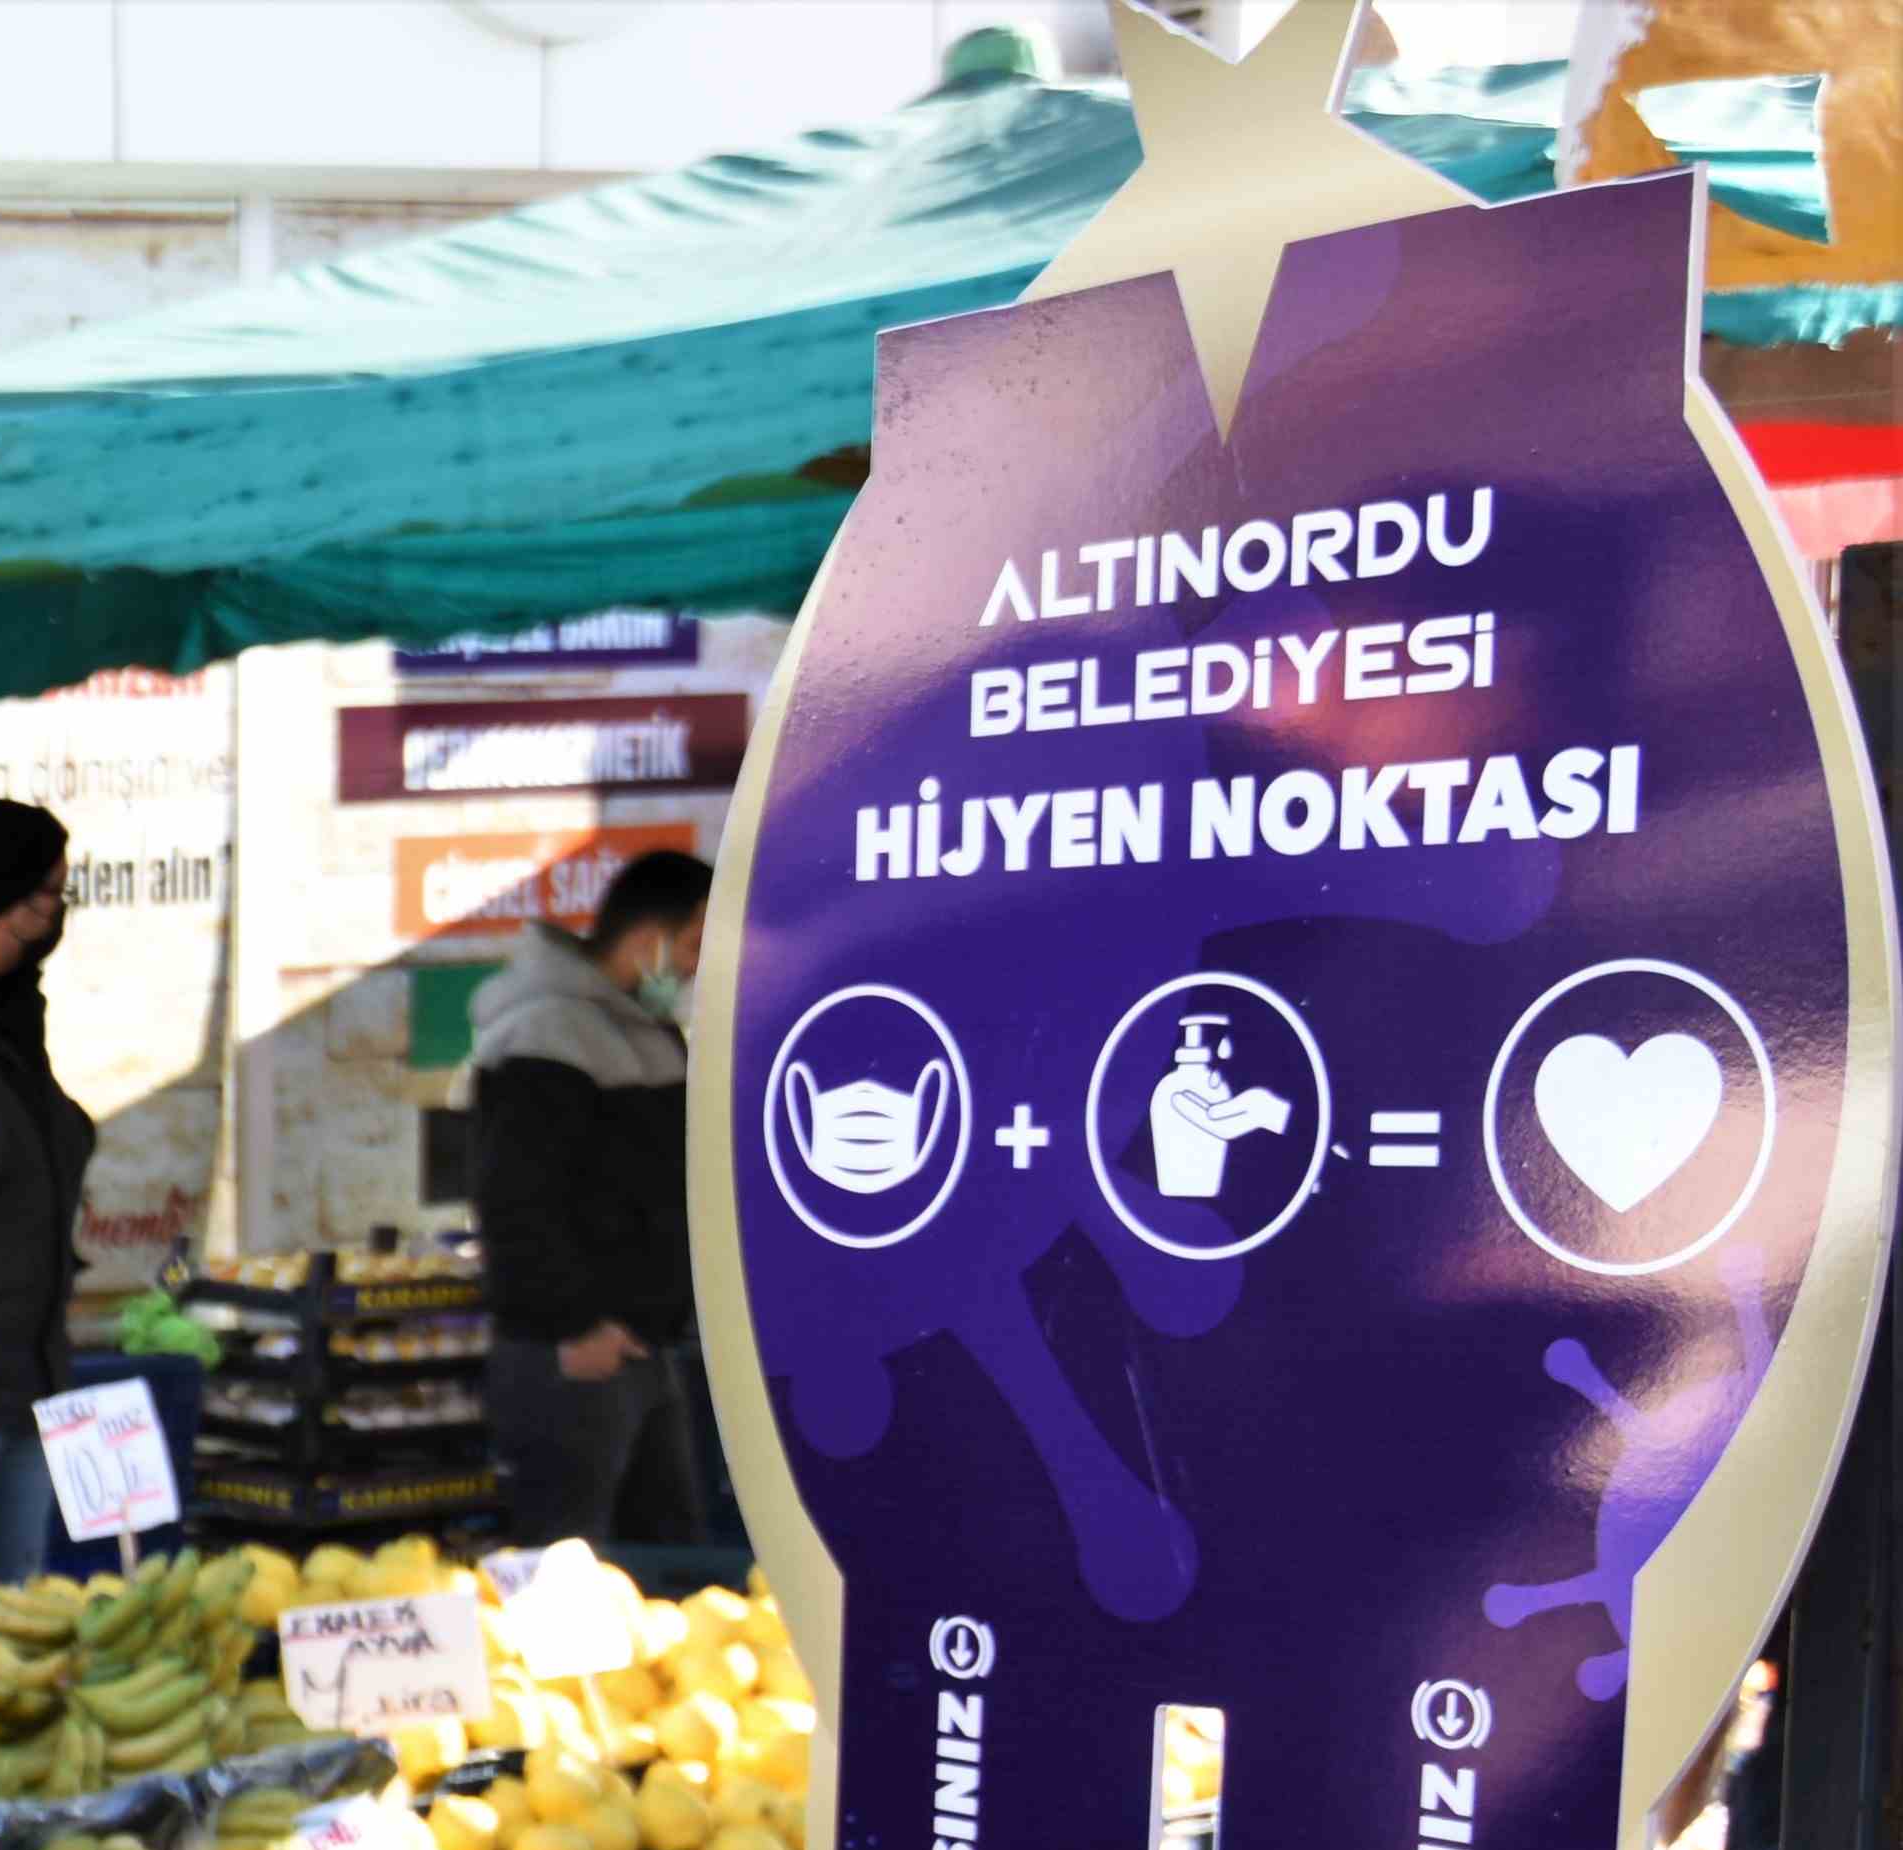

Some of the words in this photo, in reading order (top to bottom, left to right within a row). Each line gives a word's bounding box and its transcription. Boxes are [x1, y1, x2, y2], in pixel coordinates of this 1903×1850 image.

[978, 486, 1494, 628] ALTINORDU
[968, 612, 1495, 738] BELEDİYESİ
[854, 775, 1162, 882] HİJYEN
[1189, 744, 1640, 862] NOKTASI
